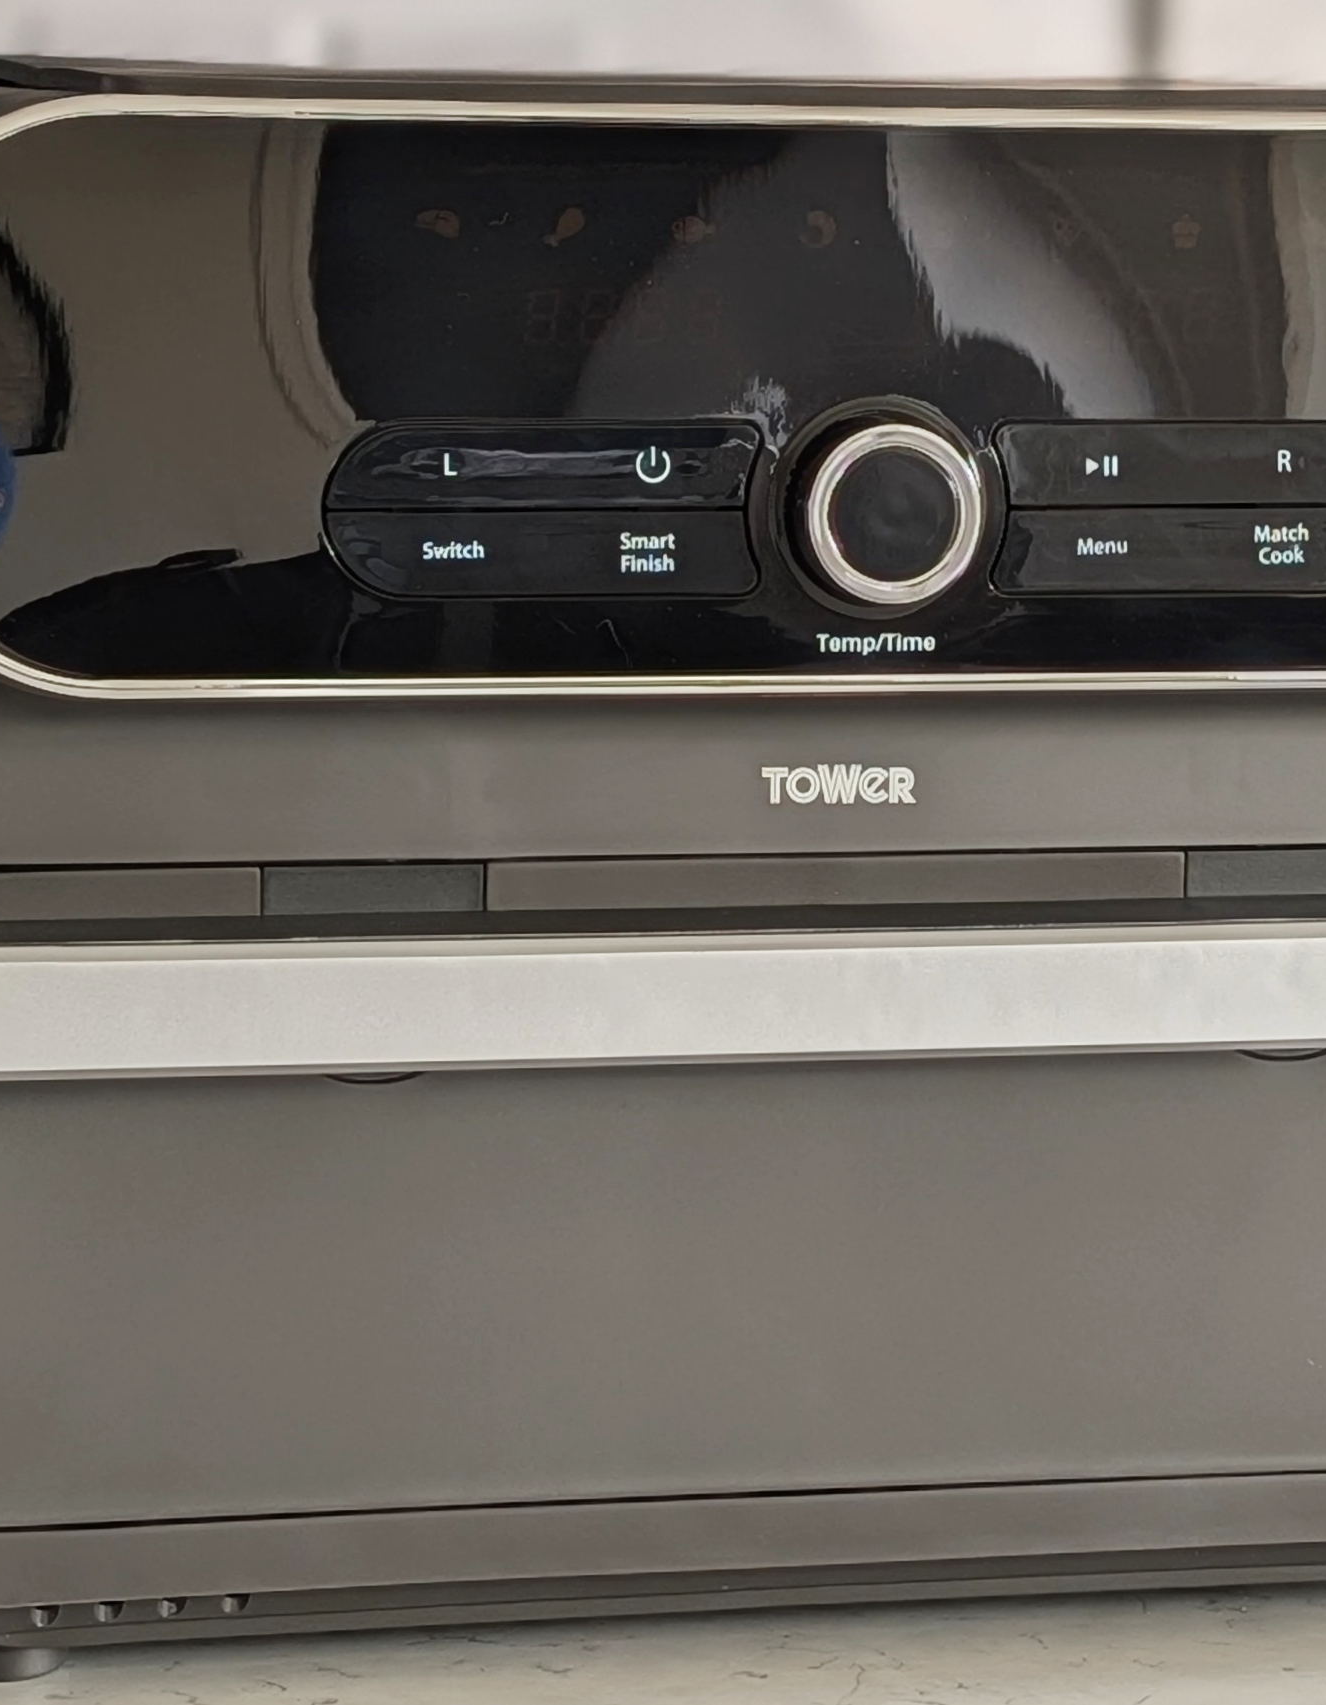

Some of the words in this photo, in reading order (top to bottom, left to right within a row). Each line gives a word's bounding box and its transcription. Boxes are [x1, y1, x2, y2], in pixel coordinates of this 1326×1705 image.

[443, 452, 458, 477] L
[1277, 449, 1292, 473] R
[619, 532, 676, 551] Smart
[1253, 523, 1310, 544] Match
[422, 540, 485, 560] Switch
[1076, 537, 1128, 556] Menu
[1257, 544, 1305, 565] Cook
[619, 553, 676, 573] Finish
[816, 632, 936, 656] Temp/Time
